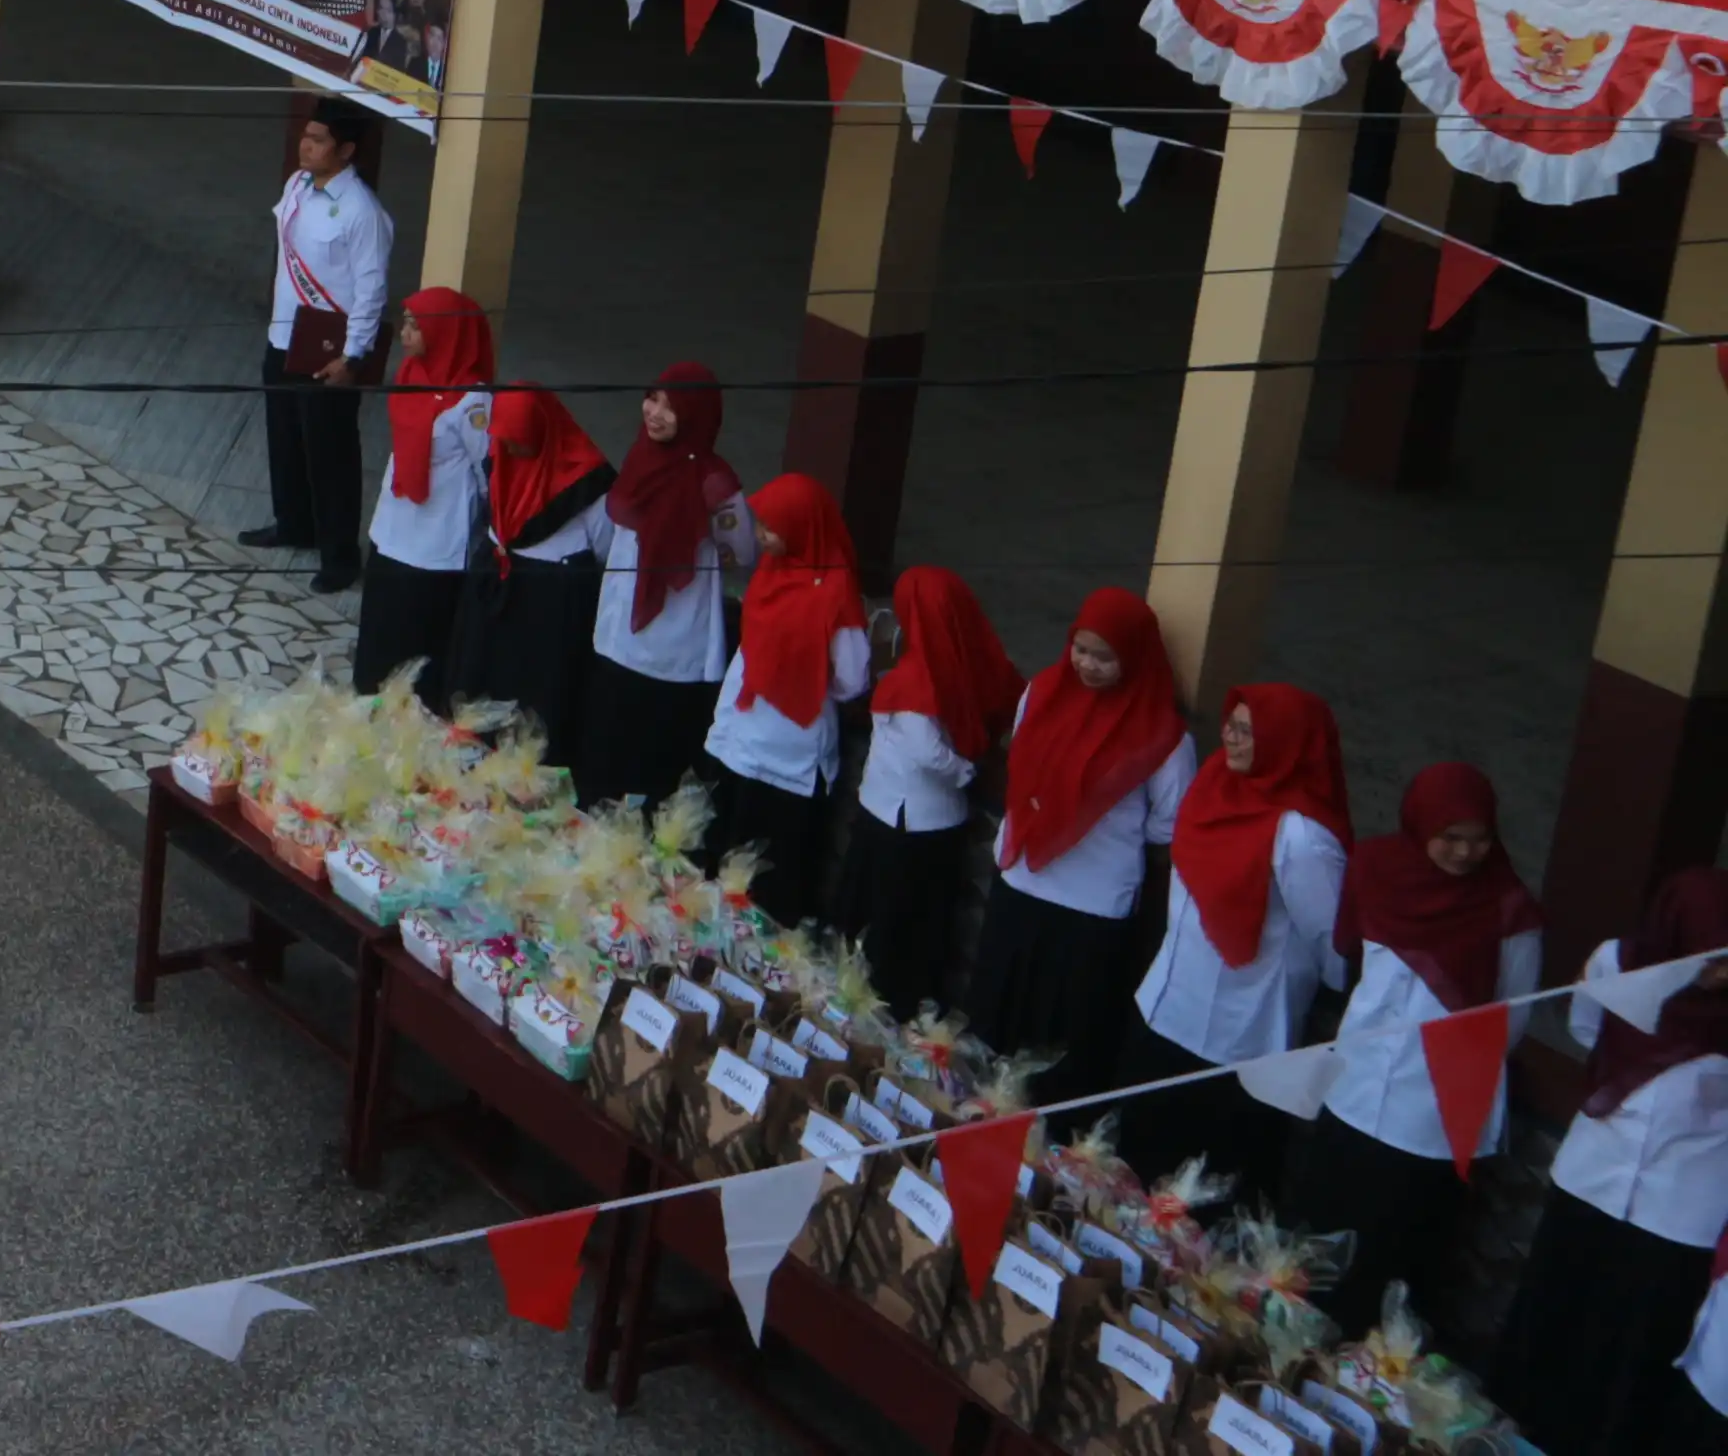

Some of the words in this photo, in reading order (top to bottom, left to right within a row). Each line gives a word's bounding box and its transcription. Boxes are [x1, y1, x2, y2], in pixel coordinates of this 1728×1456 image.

[195, 3, 224, 21] Adil
[227, 14, 248, 33] dan
[251, 26, 298, 55] Makmur
[267, 4, 295, 26] CINTA
[296, 18, 350, 49] INDONESIA
[722, 1065, 753, 1094] JUARA
[1011, 1263, 1048, 1292] JUARA
